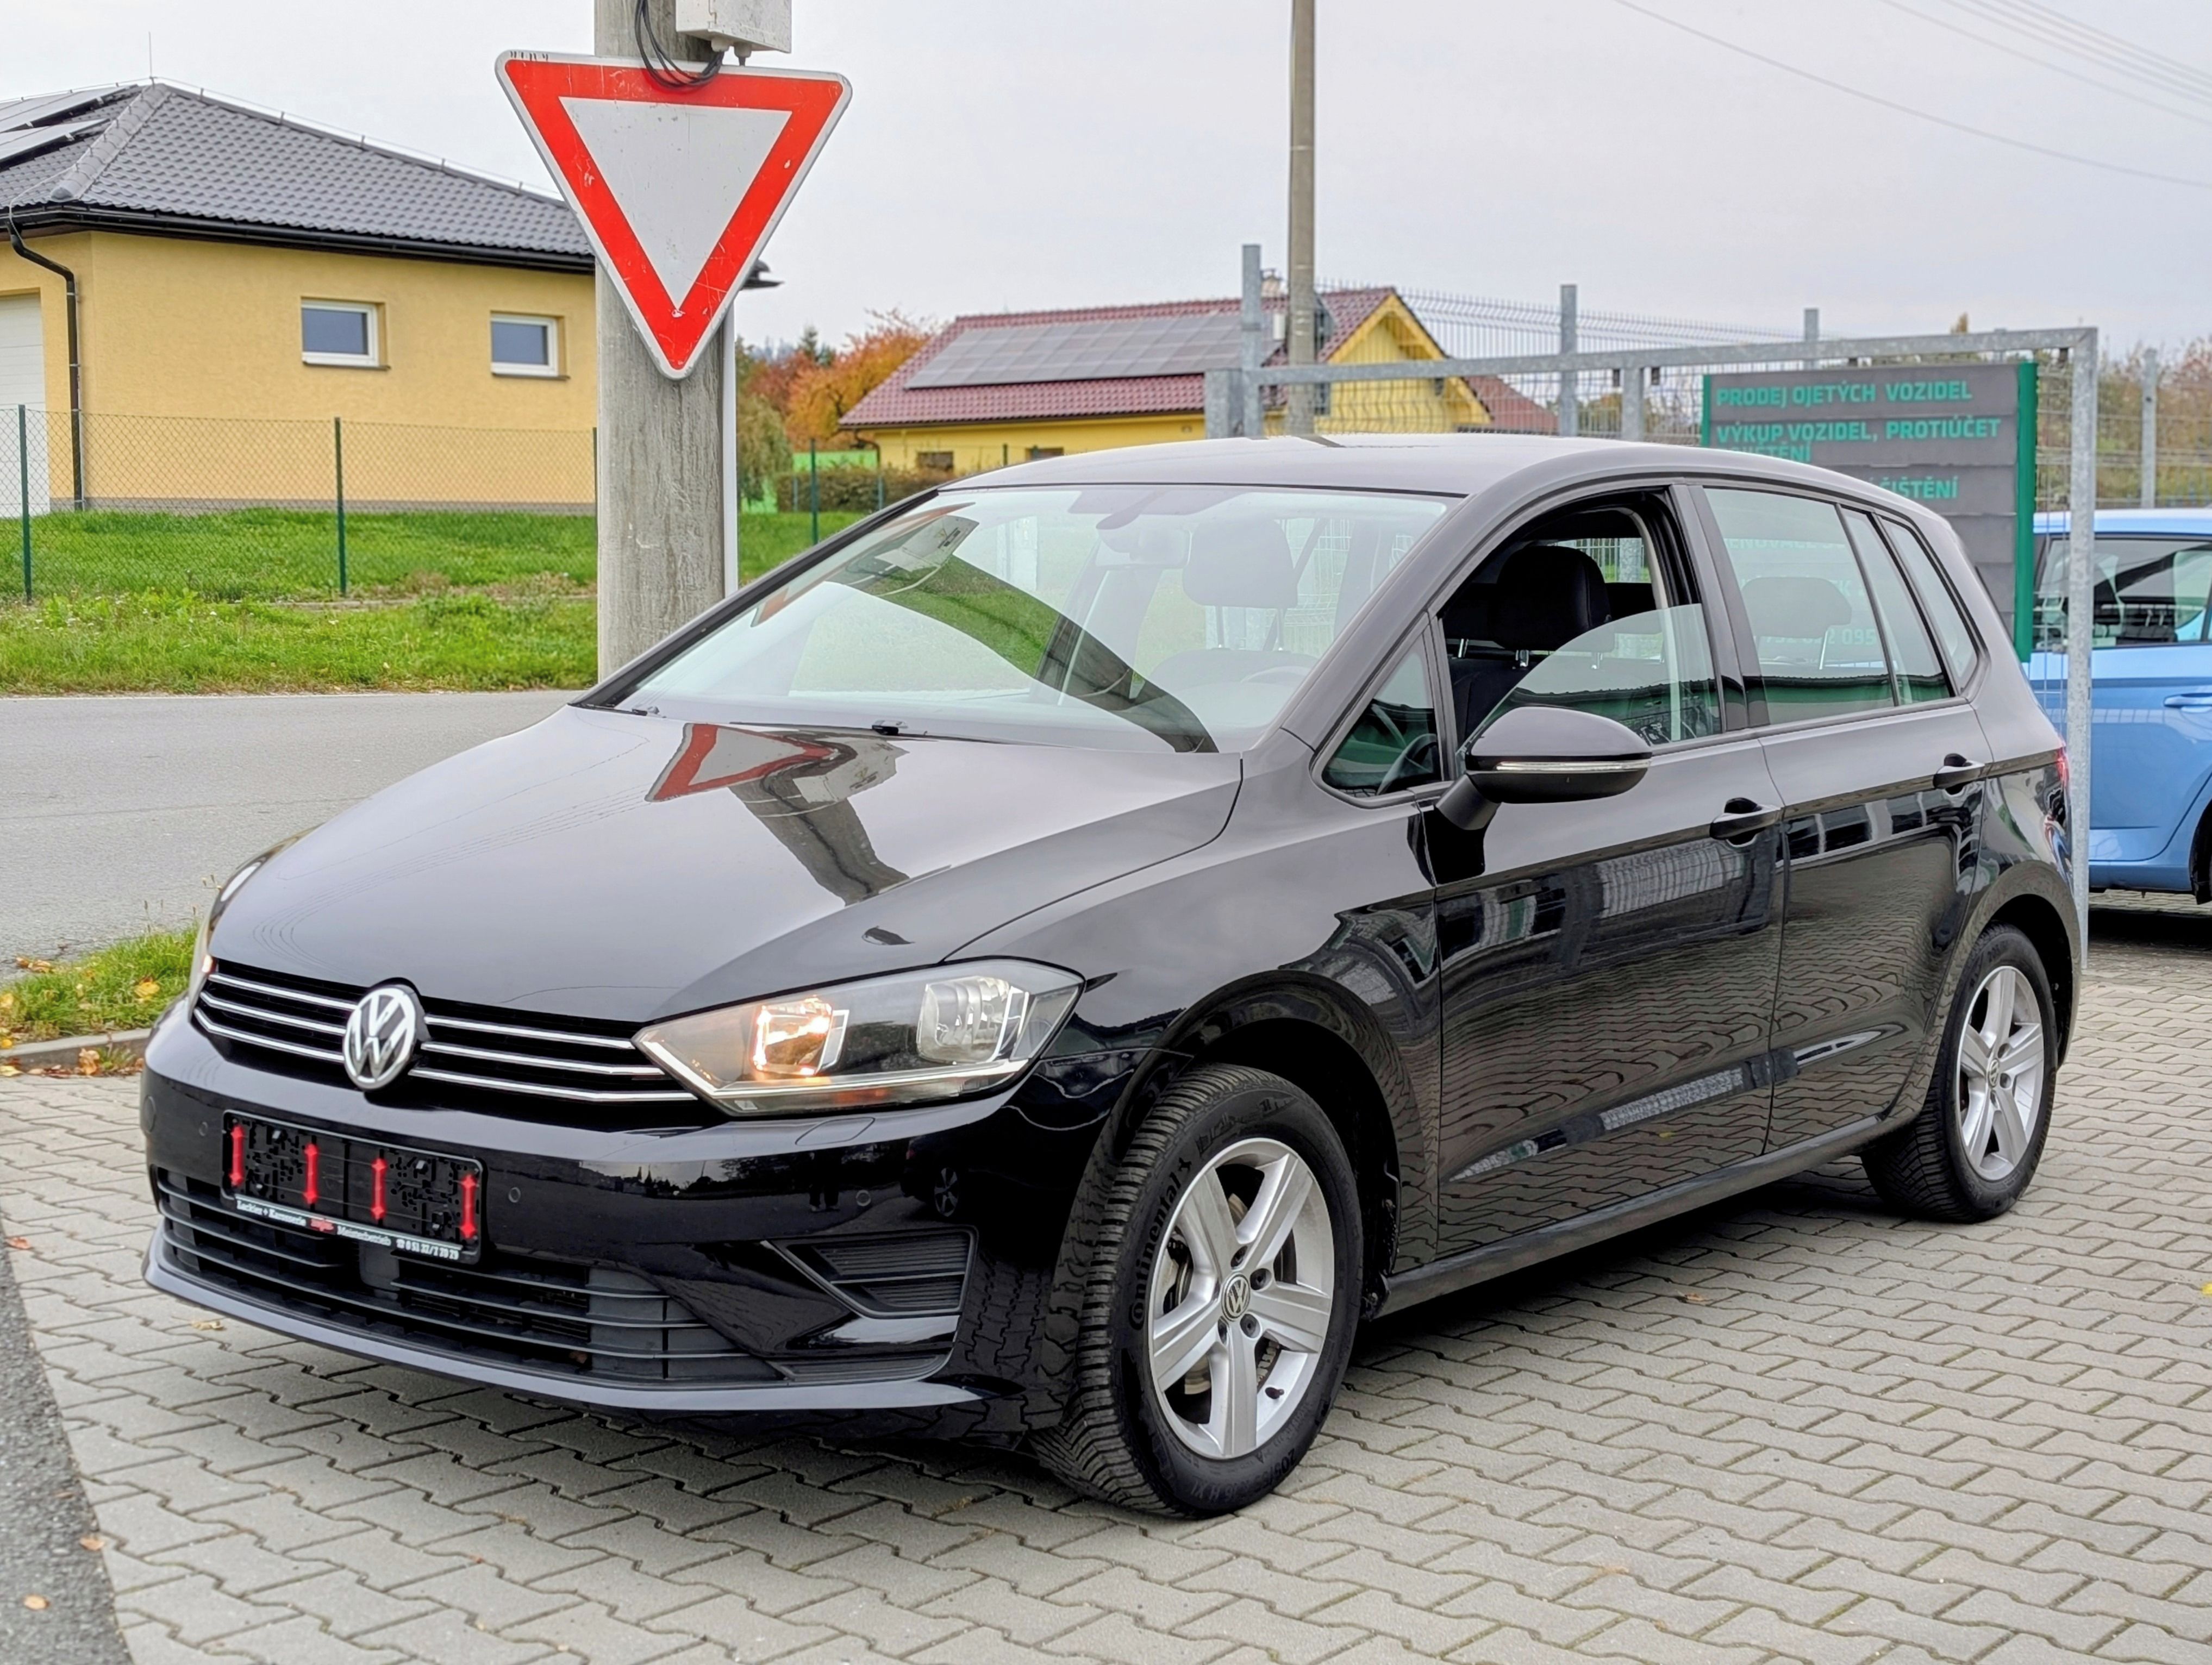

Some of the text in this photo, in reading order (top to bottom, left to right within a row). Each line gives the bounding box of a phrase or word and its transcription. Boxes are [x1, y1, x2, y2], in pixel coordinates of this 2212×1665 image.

[1716, 380, 1973, 408] PRODEJ OJETÝCH VOZIDEL
[1716, 414, 2001, 443] VÝKUP VOZIDEL, PROTIÚČET
[1129, 1171, 1182, 1331] Continental
